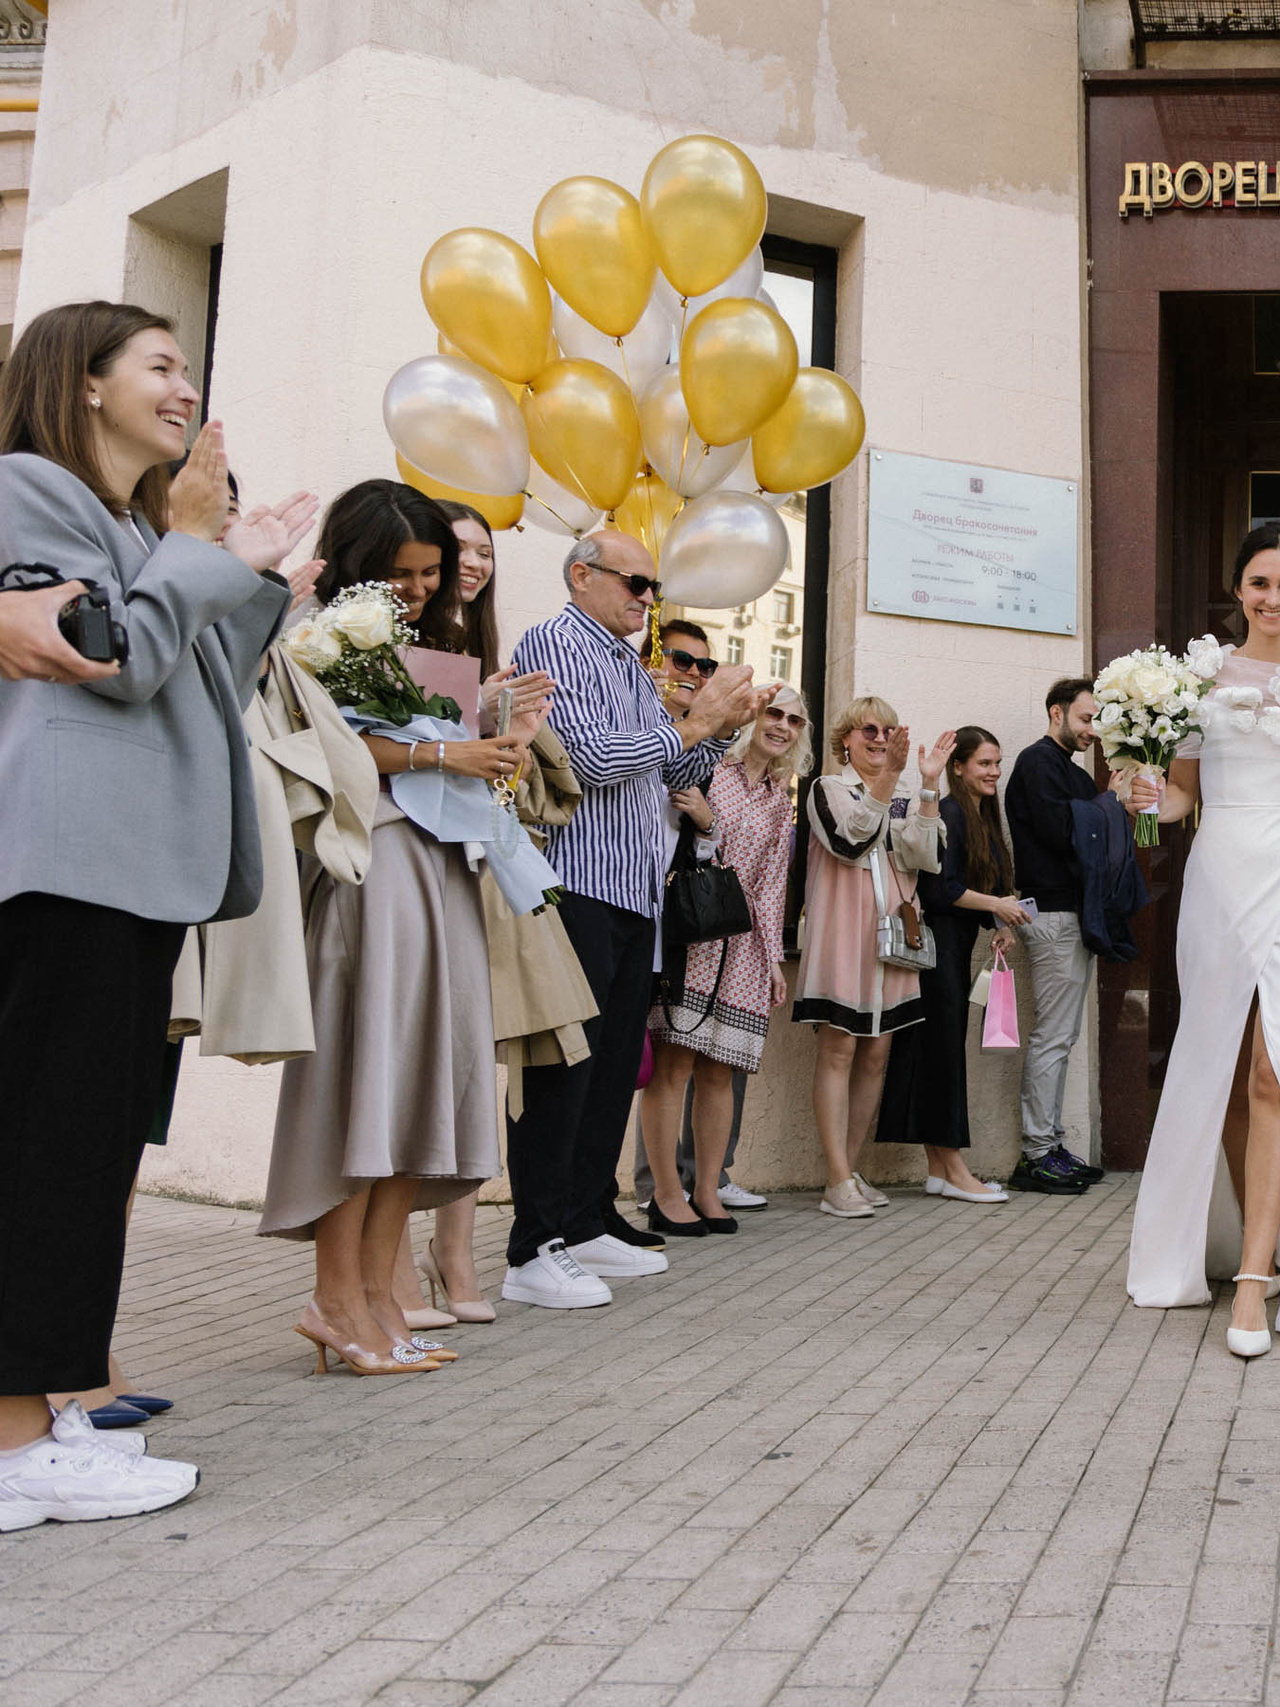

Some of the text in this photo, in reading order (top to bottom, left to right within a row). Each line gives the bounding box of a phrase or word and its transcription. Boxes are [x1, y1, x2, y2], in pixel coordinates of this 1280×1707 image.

[912, 509, 953, 526] Дворец
[955, 515, 1038, 537] бракосочетания
[981, 565, 1003, 577] 9:00
[1012, 569, 1037, 581] 18:00
